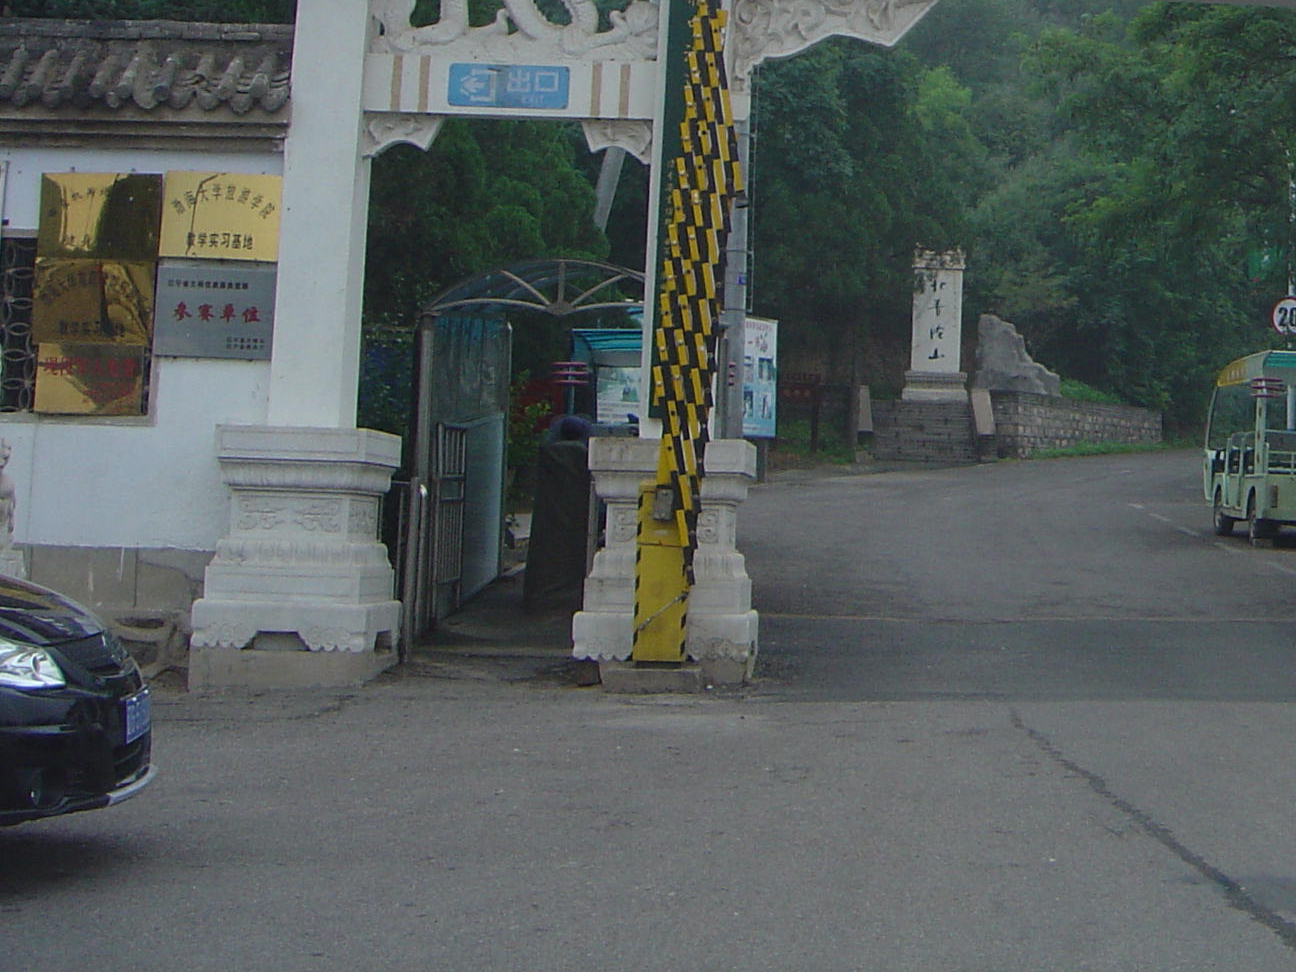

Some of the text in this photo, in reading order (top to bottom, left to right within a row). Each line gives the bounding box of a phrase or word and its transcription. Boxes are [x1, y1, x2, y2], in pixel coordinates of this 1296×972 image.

[507, 70, 559, 92] 出口
[521, 95, 545, 104] EXIT
[186, 232, 254, 251] 教学实习基地
[172, 301, 260, 323] 参赛单位
